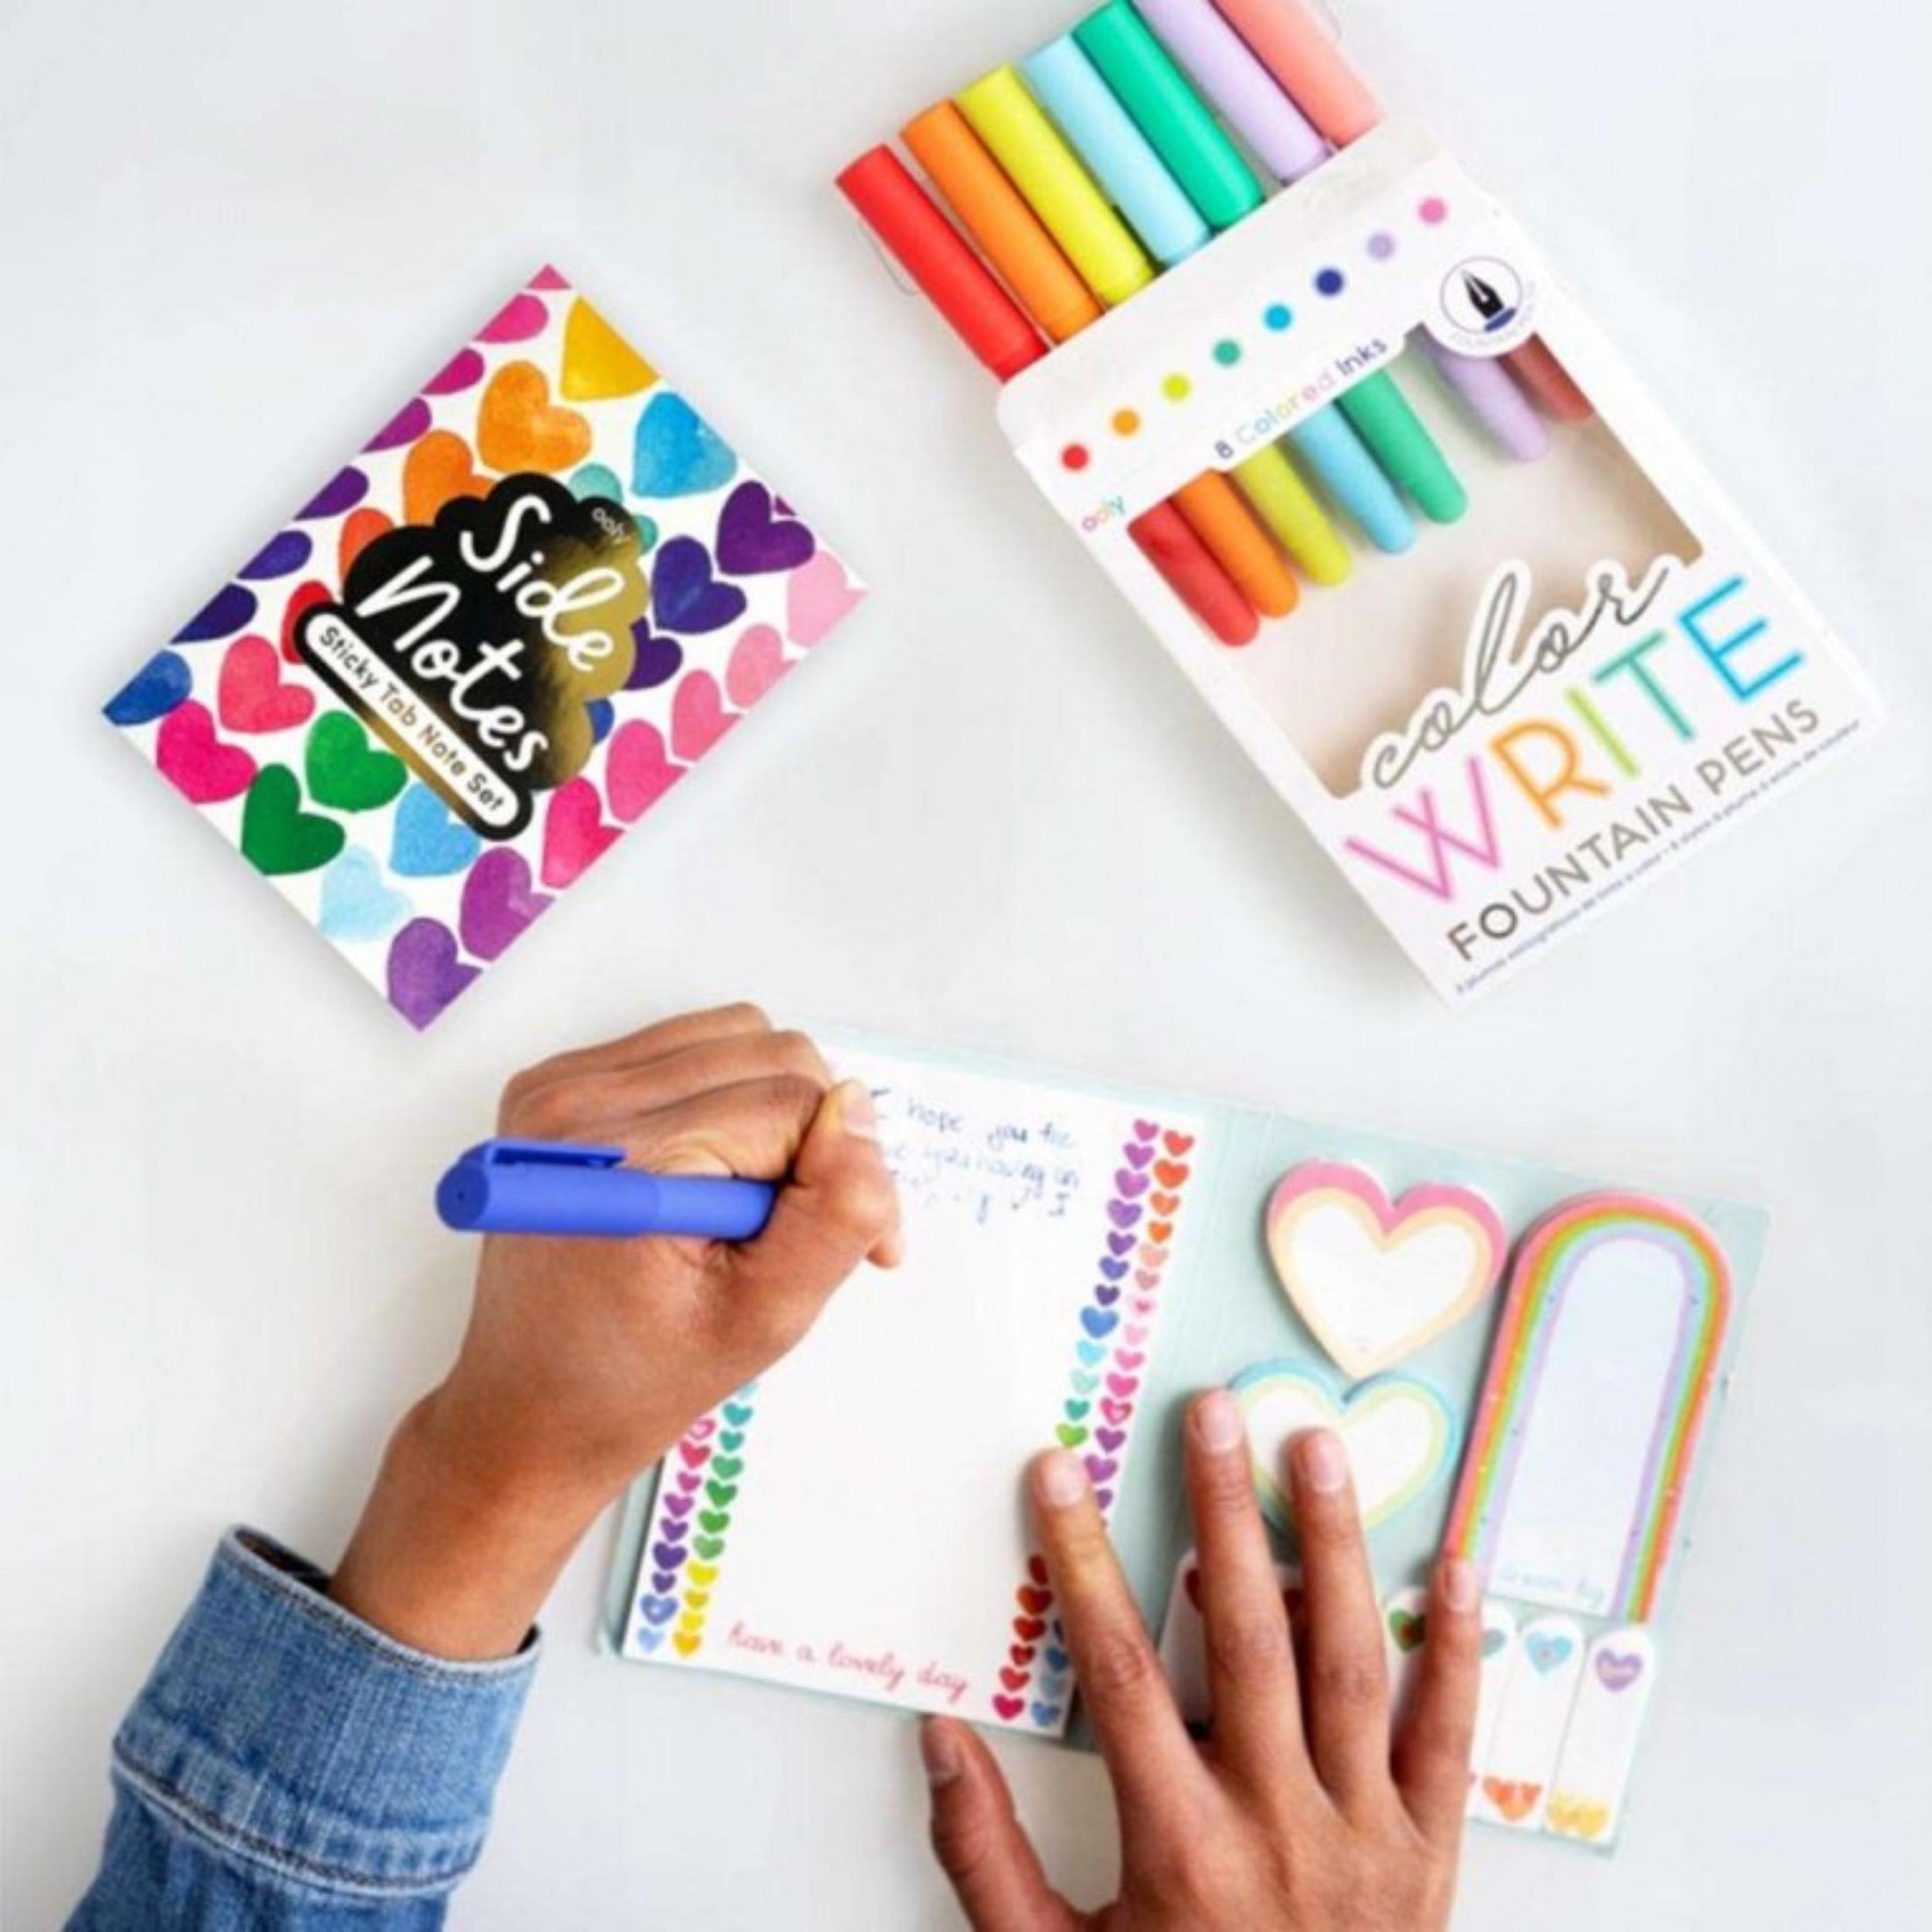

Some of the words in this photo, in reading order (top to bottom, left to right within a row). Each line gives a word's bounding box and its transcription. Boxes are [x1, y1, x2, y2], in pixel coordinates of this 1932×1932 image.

[1236, 369, 1336, 444] Colored
[1335, 338, 1388, 376] Inks
[354, 555, 550, 772] Notes
[458, 494, 625, 673] Side
[1371, 566, 1670, 789] color
[320, 626, 378, 690] Sticky
[380, 682, 417, 726] Tab
[418, 724, 466, 776] Note
[467, 773, 504, 811] Set
[1344, 573, 1806, 904] WRITE
[1447, 783, 1693, 962] FOUNTAIN
[1695, 699, 1820, 797] PENS
[727, 1621, 782, 1654] have
[797, 1645, 815, 1663] a
[827, 1641, 905, 1691] lovely
[917, 1662, 969, 1704] day
